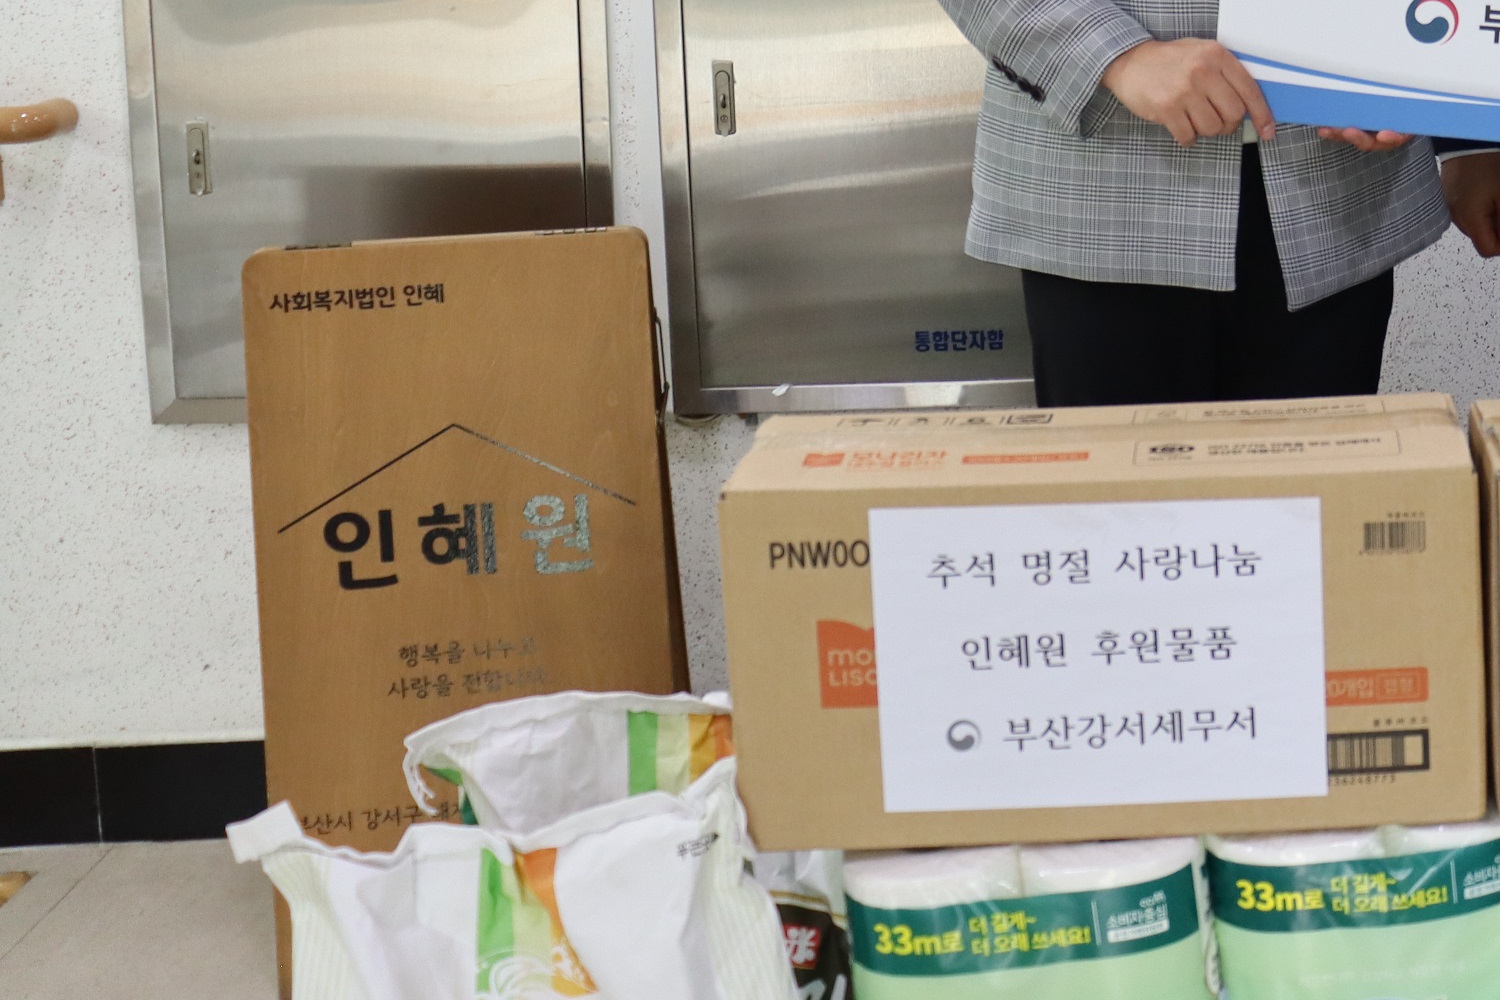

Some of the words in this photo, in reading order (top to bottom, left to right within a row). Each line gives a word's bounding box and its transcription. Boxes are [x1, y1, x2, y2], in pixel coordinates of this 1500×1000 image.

[269, 286, 396, 315] 사회복지법인
[403, 283, 446, 306] 인혜
[914, 329, 1004, 352] 통합단자함
[323, 494, 594, 592] 인혜원
[926, 551, 997, 590] 추석
[1021, 548, 1092, 586] 명절
[1114, 542, 1264, 582] 사랑나눔
[398, 640, 465, 668] 행복을
[960, 632, 1067, 673] 인혜원
[1090, 625, 1239, 665] 후원물품
[388, 674, 454, 700] 사랑을
[1002, 706, 1258, 753] 부산강서세무서
[361, 805, 424, 831] 강서구
[1235, 878, 1325, 911] 33m로
[1330, 875, 1349, 894] 더
[1352, 871, 1397, 894] 길게~
[1331, 896, 1351, 916] 더
[1353, 894, 1388, 914] 오래
[1391, 885, 1449, 911] 쓰세요!
[873, 921, 965, 957] 33m로
[968, 915, 989, 936] 더
[990, 910, 1037, 935] 길게~
[970, 936, 991, 958] 더
[993, 931, 1030, 955] 오래
[1031, 925, 1093, 951] 쓰세요!
